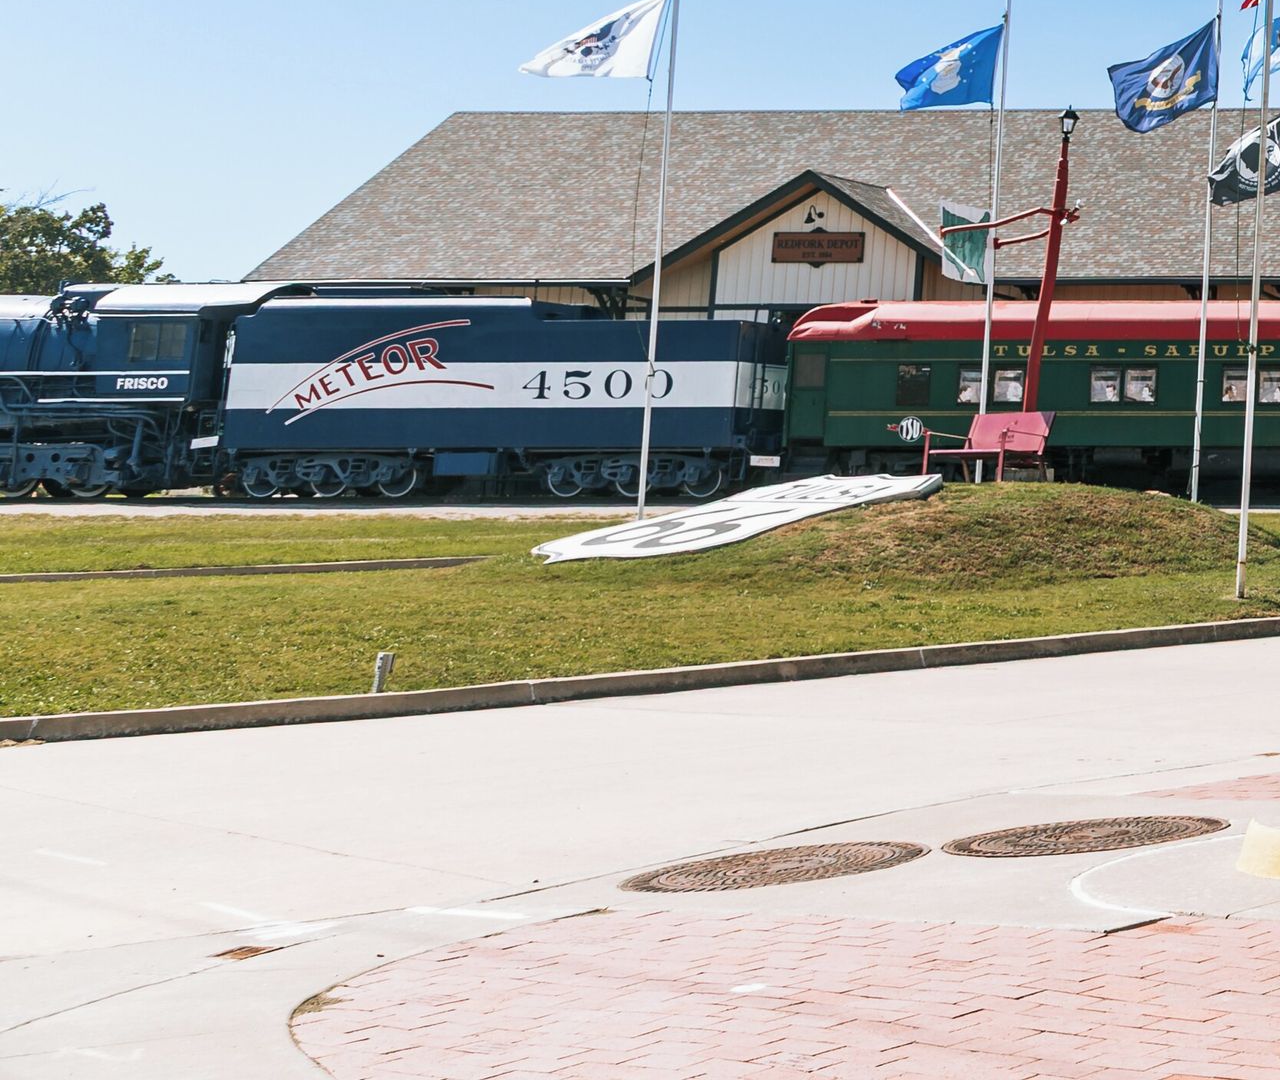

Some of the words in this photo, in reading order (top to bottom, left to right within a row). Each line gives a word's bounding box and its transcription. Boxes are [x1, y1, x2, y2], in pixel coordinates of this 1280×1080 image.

[827, 239, 859, 249] DEPOT
[994, 345, 1099, 357] TULSA
[116, 377, 168, 389] FRISCO
[294, 337, 448, 409] METEOR
[522, 370, 673, 399] 4500
[581, 506, 799, 549] 66
